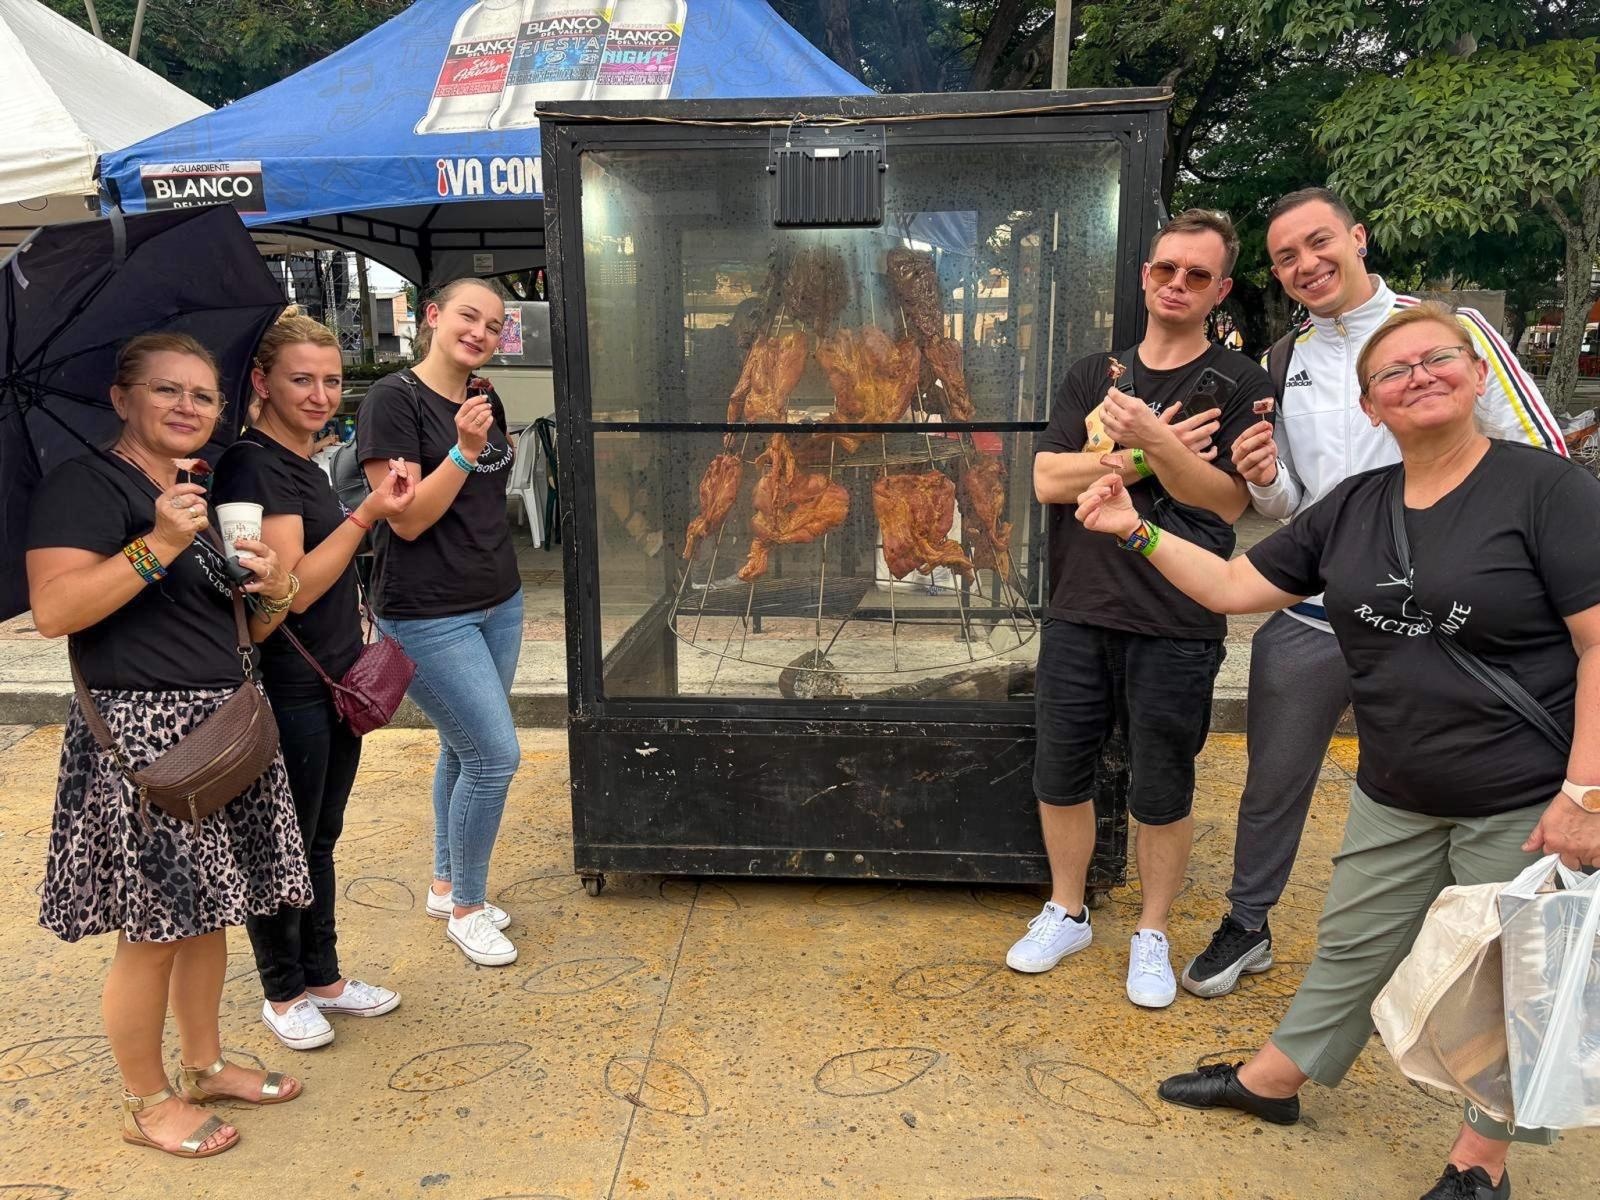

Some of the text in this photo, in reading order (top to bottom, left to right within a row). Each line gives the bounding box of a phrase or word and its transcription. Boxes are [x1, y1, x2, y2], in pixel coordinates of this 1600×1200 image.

[526, 17, 602, 35] BLANCO
[607, 29, 673, 42] BLANCO
[518, 36, 600, 55] FIESTA
[602, 50, 669, 65] NIGHT
[171, 163, 230, 173] AGUARDIENTE
[489, 156, 544, 195] CON
[152, 176, 253, 199] BLANCO
[195, 554, 233, 600] RACIBO
